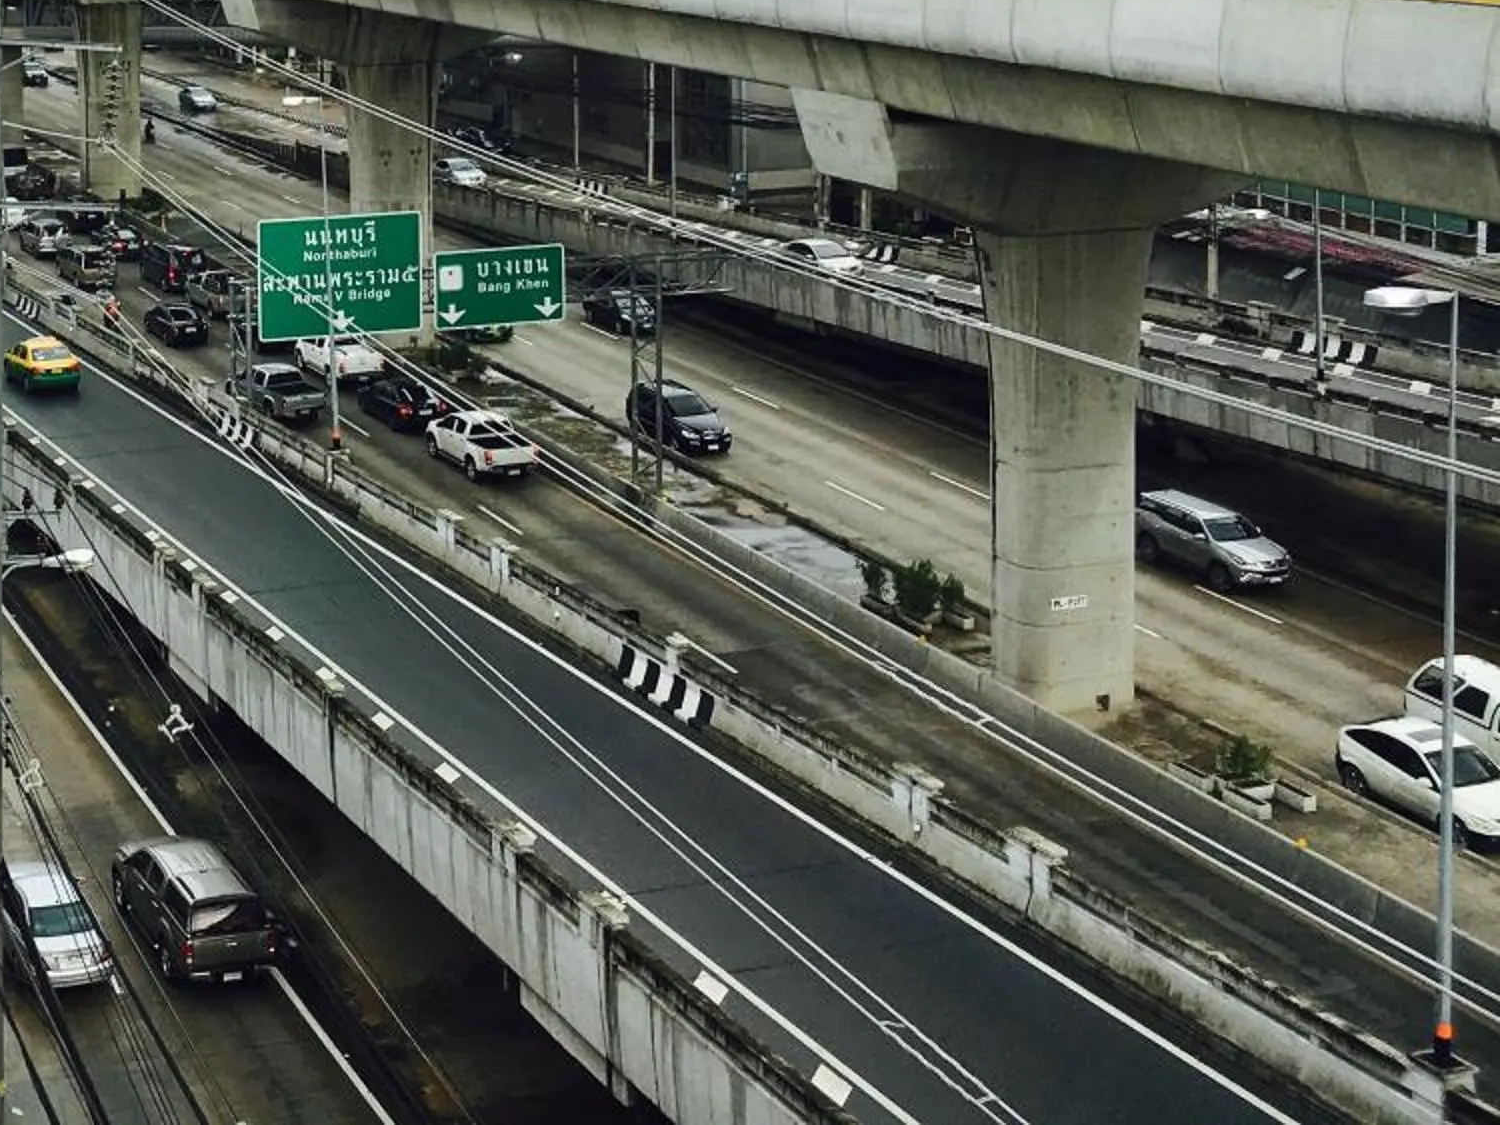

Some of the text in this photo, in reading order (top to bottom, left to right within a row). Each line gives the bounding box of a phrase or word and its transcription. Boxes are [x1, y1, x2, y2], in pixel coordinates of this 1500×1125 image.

[303, 220, 377, 248] นนทบุรี
[303, 248, 377, 262] Nonthaburi
[476, 256, 550, 279] บางเขน
[477, 275, 550, 294] Bang Khen
[293, 288, 391, 305] Rama V Bridge
